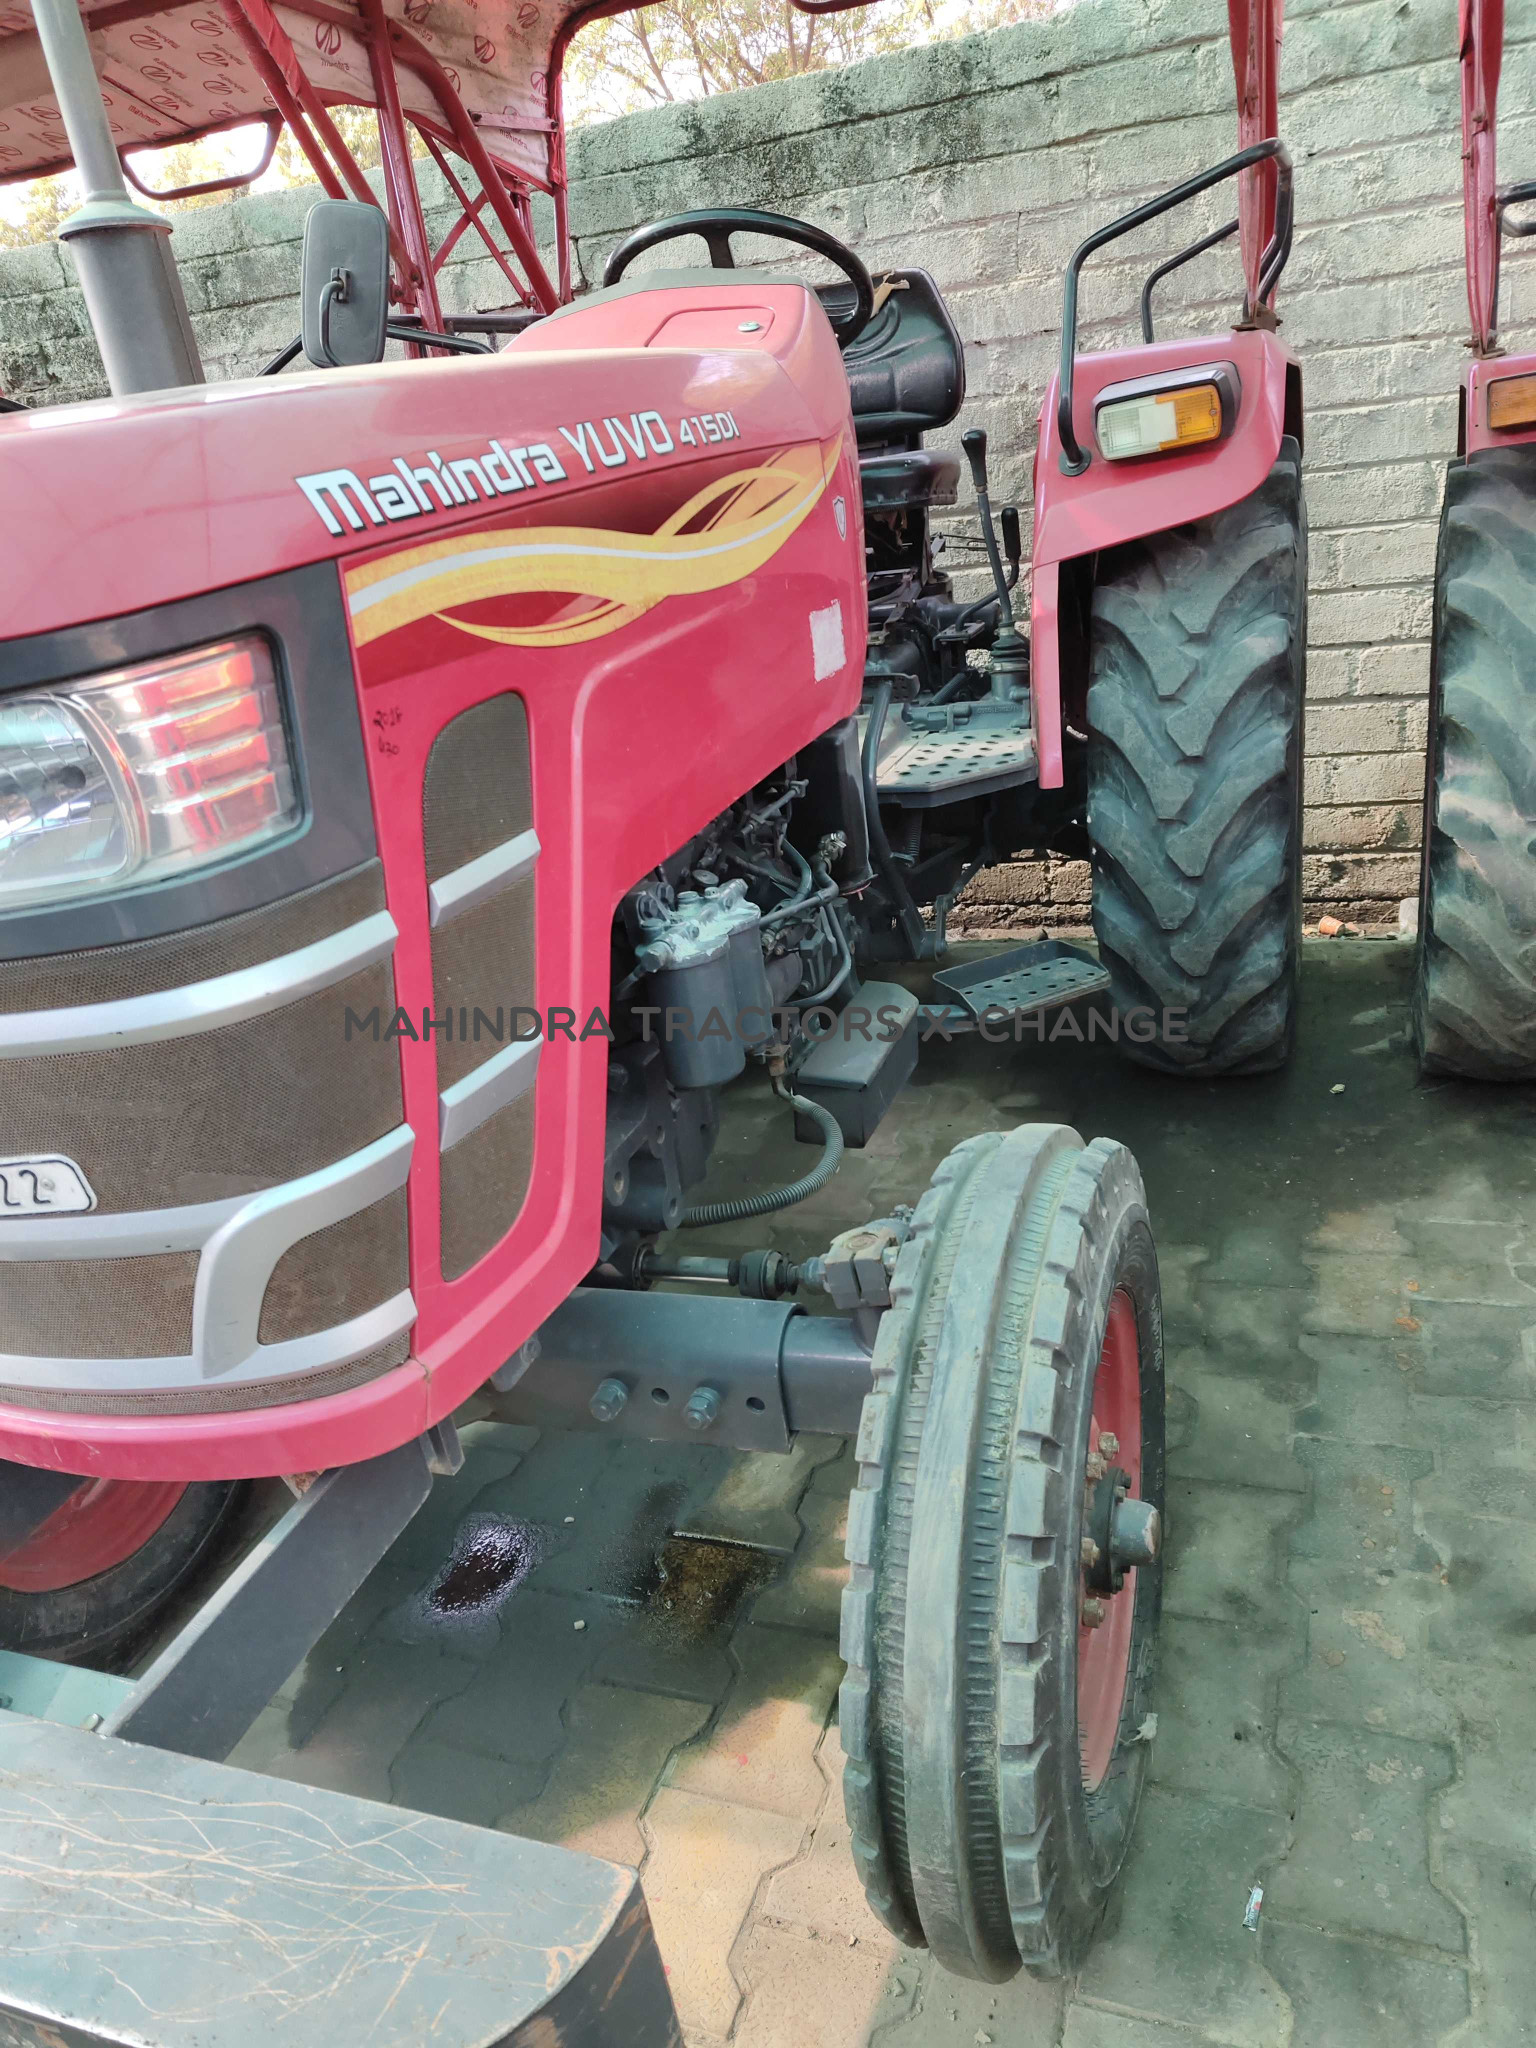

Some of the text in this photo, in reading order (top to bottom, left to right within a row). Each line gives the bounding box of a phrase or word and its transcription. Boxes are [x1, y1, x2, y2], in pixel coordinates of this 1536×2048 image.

[295, 410, 741, 537] Mahindra YUVO 415DI
